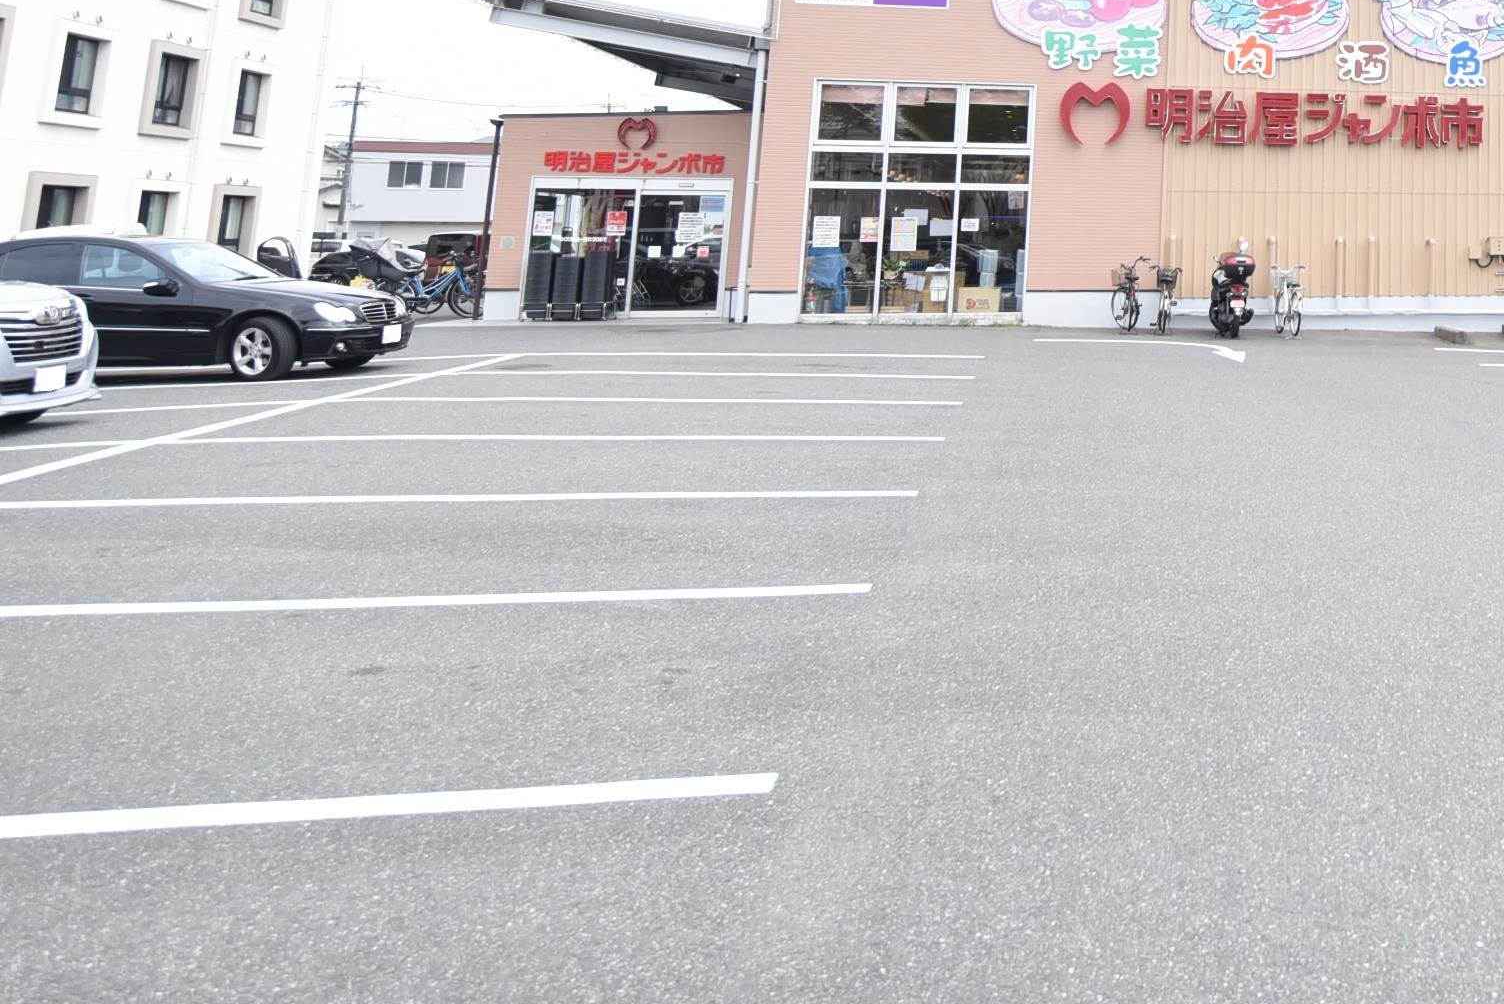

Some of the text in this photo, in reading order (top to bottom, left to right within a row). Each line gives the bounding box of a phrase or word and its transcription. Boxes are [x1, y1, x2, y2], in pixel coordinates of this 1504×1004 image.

[1044, 25, 1485, 86] 野菜 肉 酒 魚
[1145, 87, 1484, 148] 明治屋ジャンボ市
[544, 151, 725, 175] 明治屋ジャンボ市
